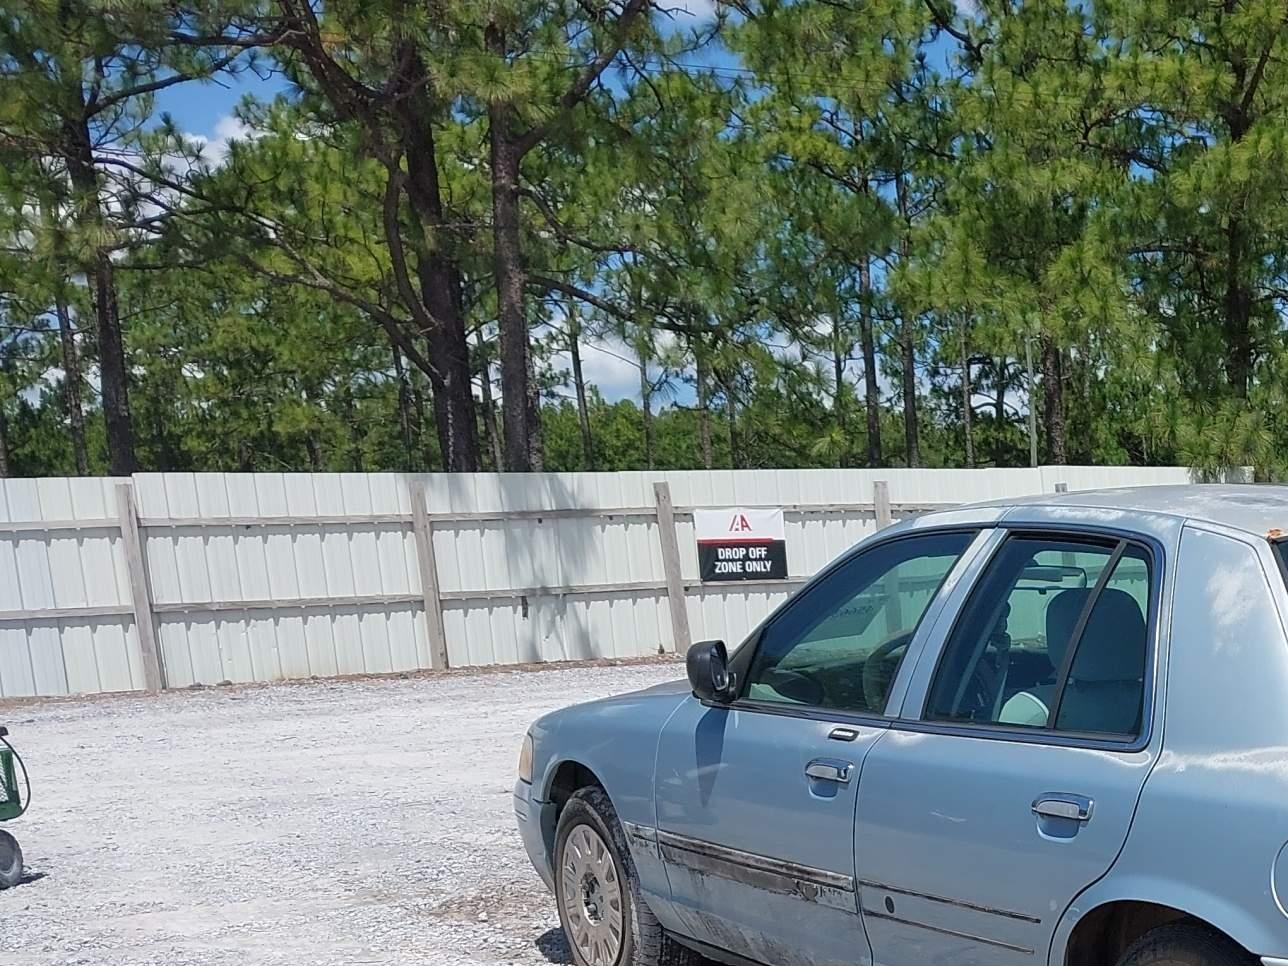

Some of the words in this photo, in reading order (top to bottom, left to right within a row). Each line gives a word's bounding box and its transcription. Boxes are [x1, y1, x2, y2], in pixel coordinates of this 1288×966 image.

[717, 547, 747, 560] DROP
[748, 547, 768, 559] OFF
[714, 561, 744, 574] ZONE
[745, 560, 772, 572] ONLY
